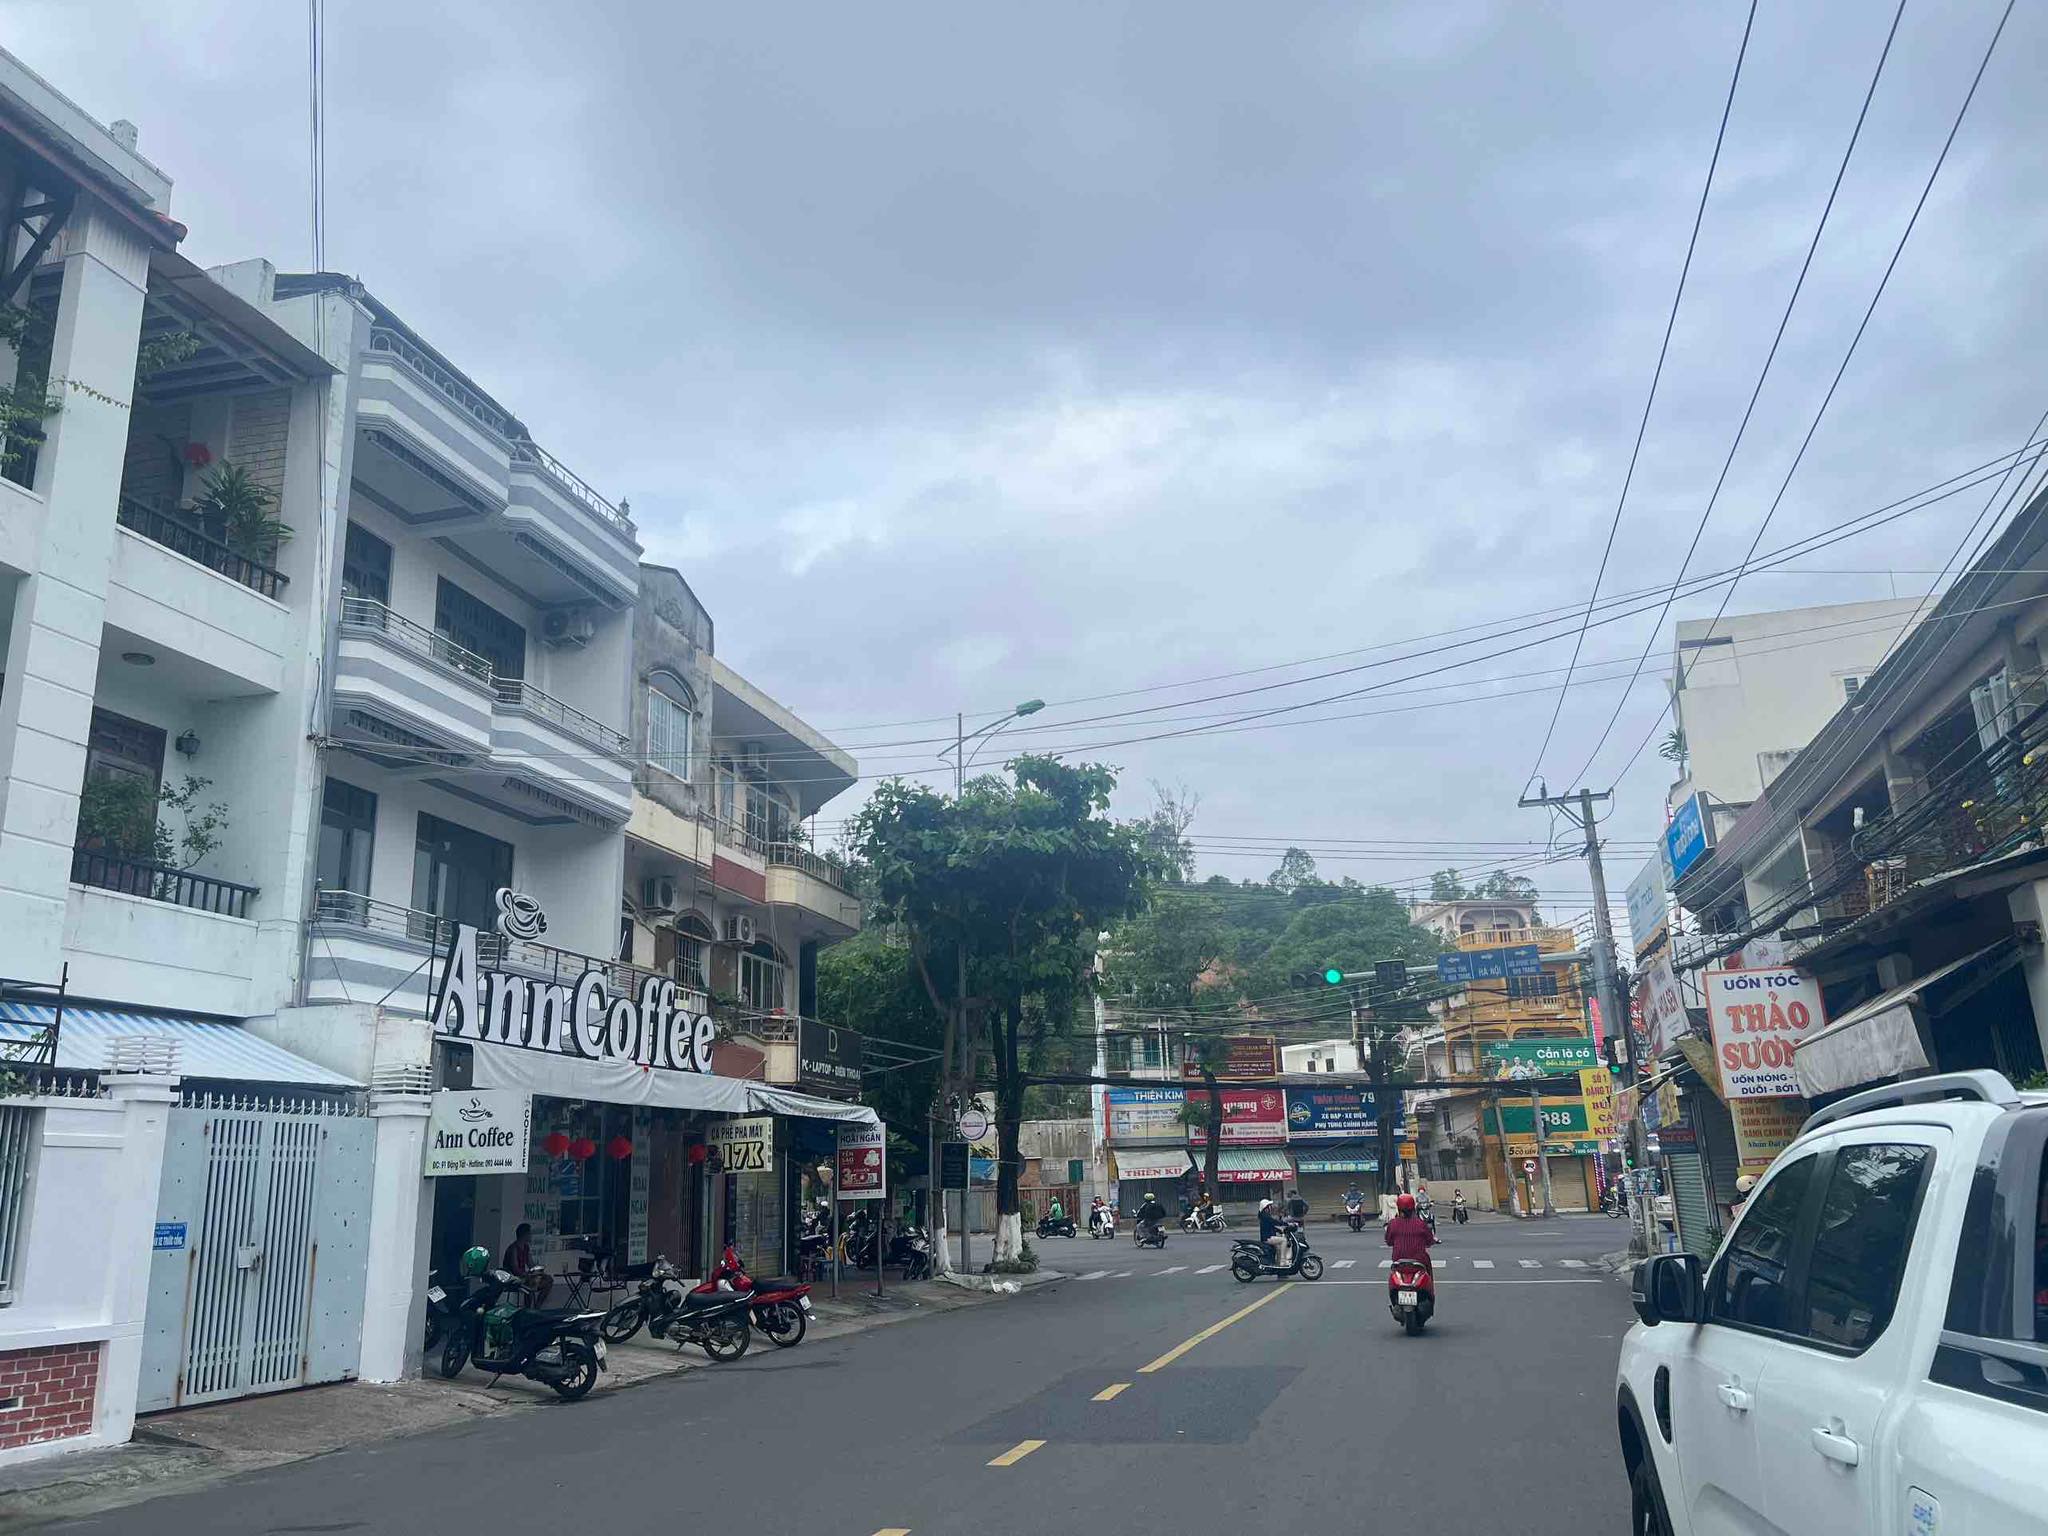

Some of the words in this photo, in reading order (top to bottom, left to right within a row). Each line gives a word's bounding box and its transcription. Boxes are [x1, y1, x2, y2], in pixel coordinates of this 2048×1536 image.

[1724, 974, 1760, 991] UỐN
[1764, 973, 1799, 987] TÓC
[1727, 990, 1810, 1034] THẢO
[1536, 1047, 1559, 1059] Cần
[1563, 1048, 1573, 1058] là
[1576, 1047, 1590, 1058] có
[812, 1061, 831, 1075] LAPTOP
[1134, 1089, 1163, 1101] THIÊN
[1165, 1090, 1184, 1100] KIM
[1360, 1092, 1375, 1103] 79
[1223, 1101, 1257, 1113] quang
[721, 1122, 733, 1139] PHÊ
[735, 1125, 747, 1138] PHA
[749, 1122, 763, 1138] MÁY
[435, 1130, 464, 1149] Ann
[468, 1127, 514, 1148] Coffee
[723, 1140, 765, 1171] 17K
[1125, 1169, 1161, 1177] THIÊN
[1237, 1171, 1260, 1181] HIỆP
